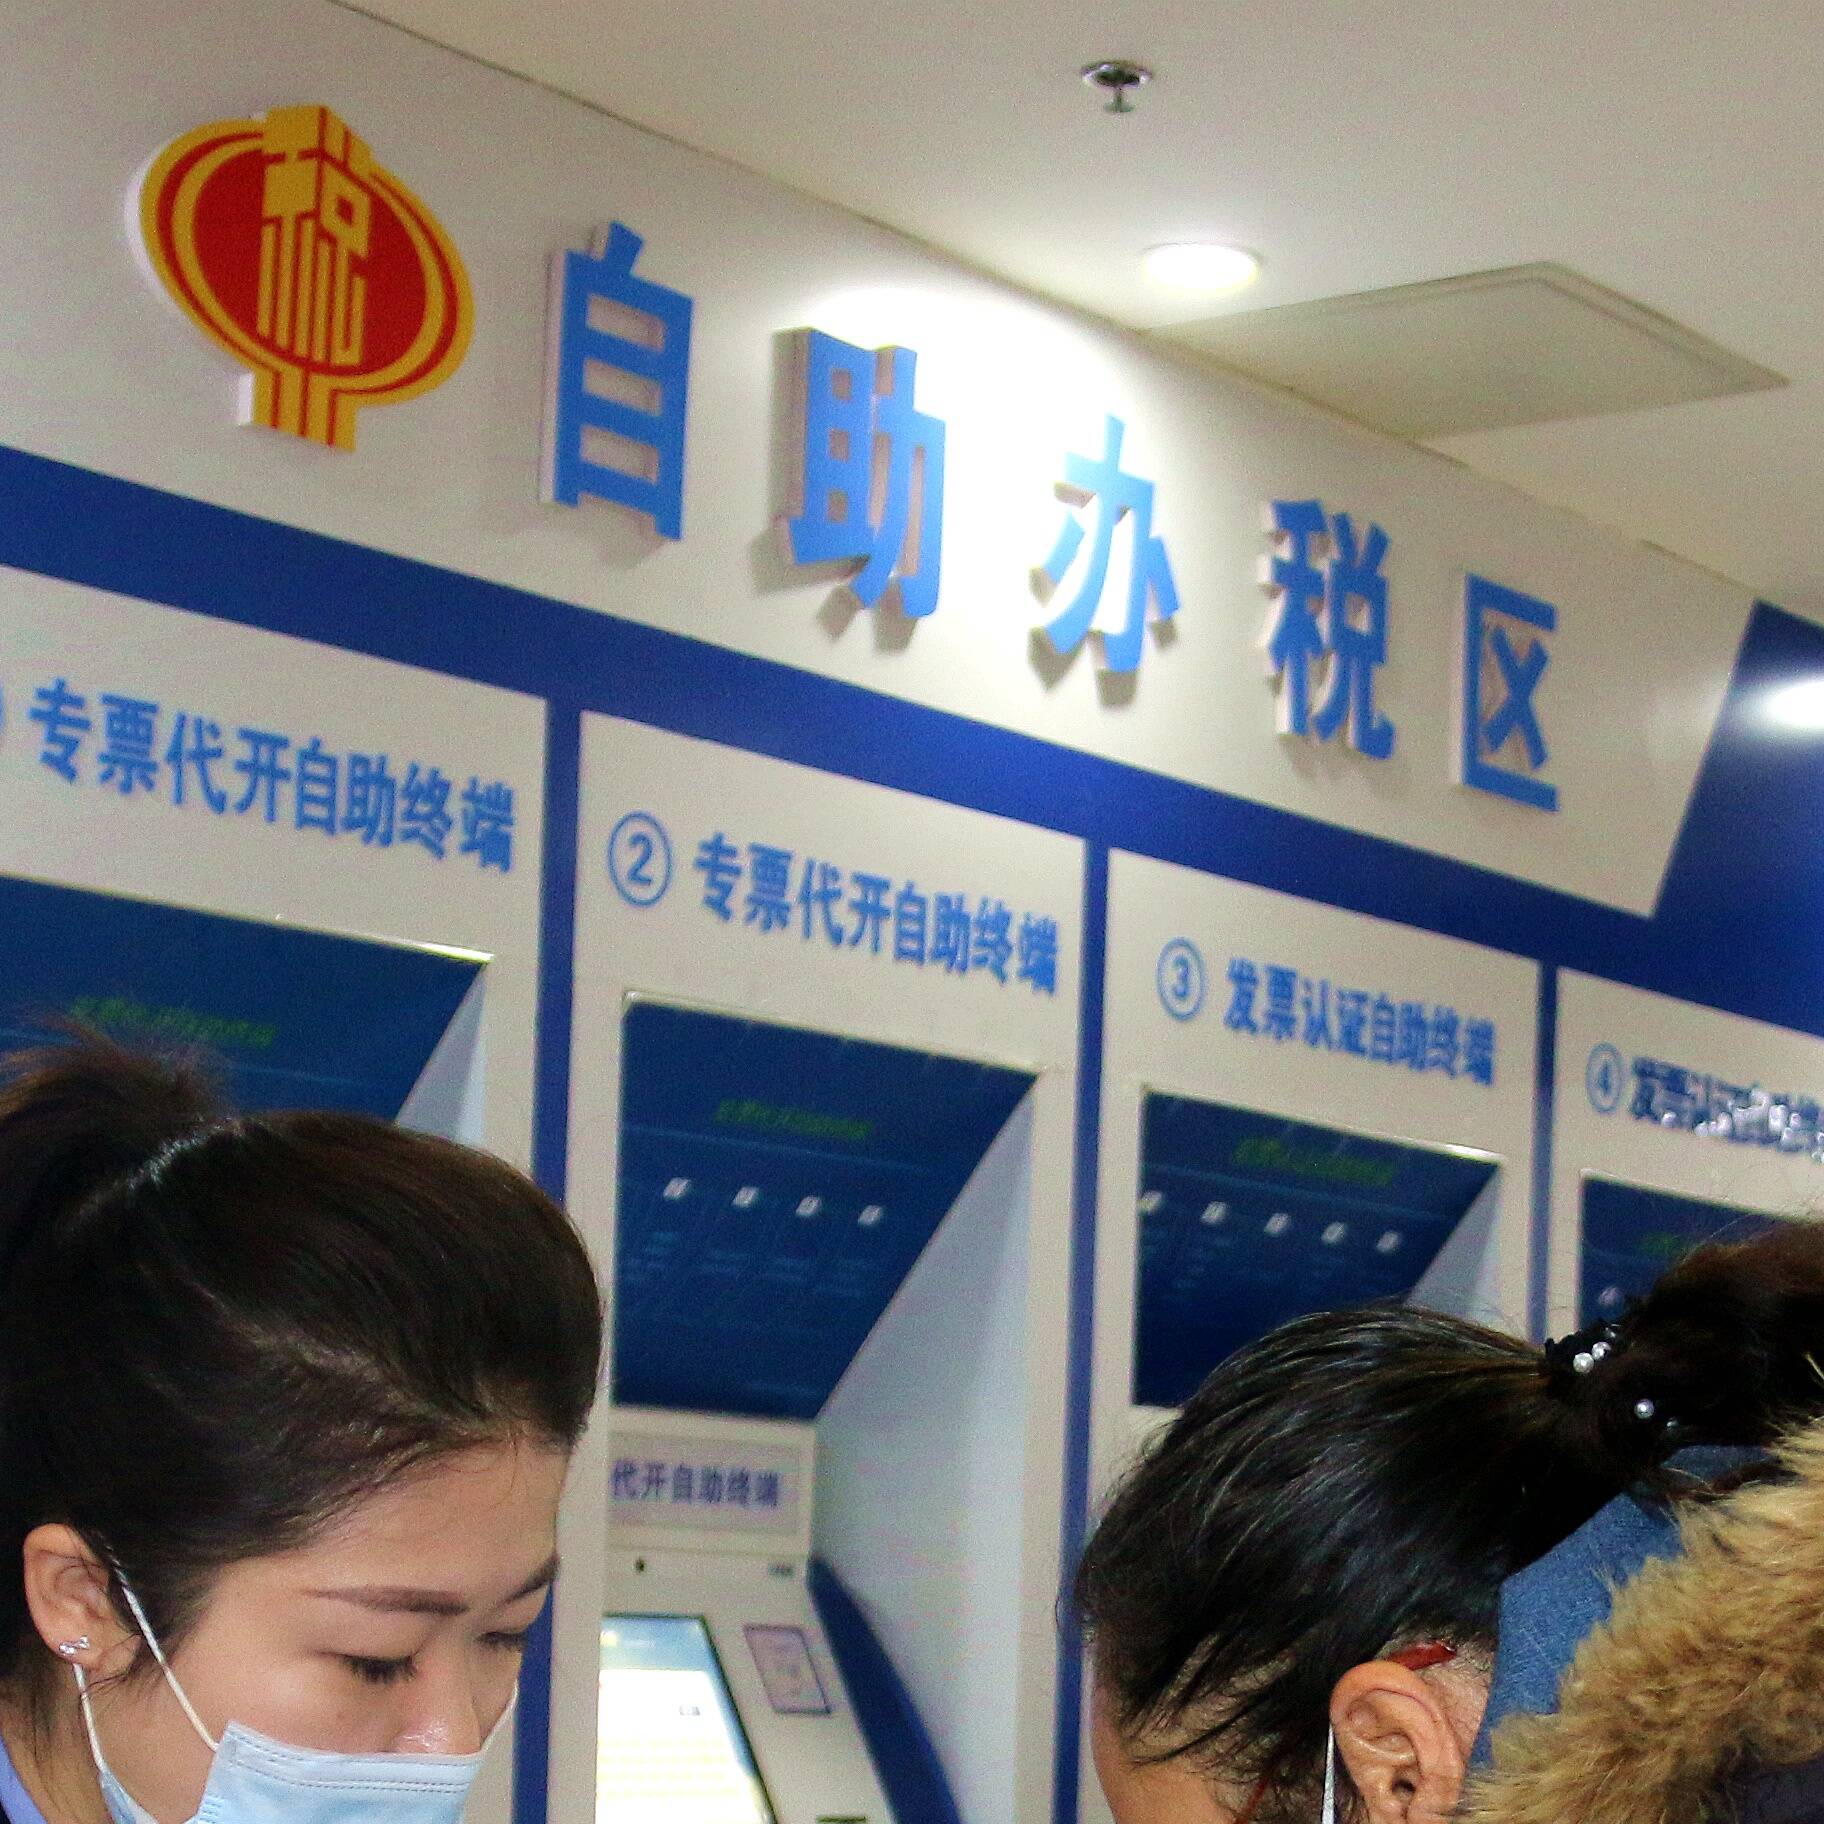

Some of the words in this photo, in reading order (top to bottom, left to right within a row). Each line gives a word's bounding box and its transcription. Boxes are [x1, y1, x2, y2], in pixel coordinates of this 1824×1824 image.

[540, 221, 1560, 812] 自助办税区
[28, 678, 516, 874] 专票代开自助终端
[692, 832, 1059, 997] 专票代开自助终端
